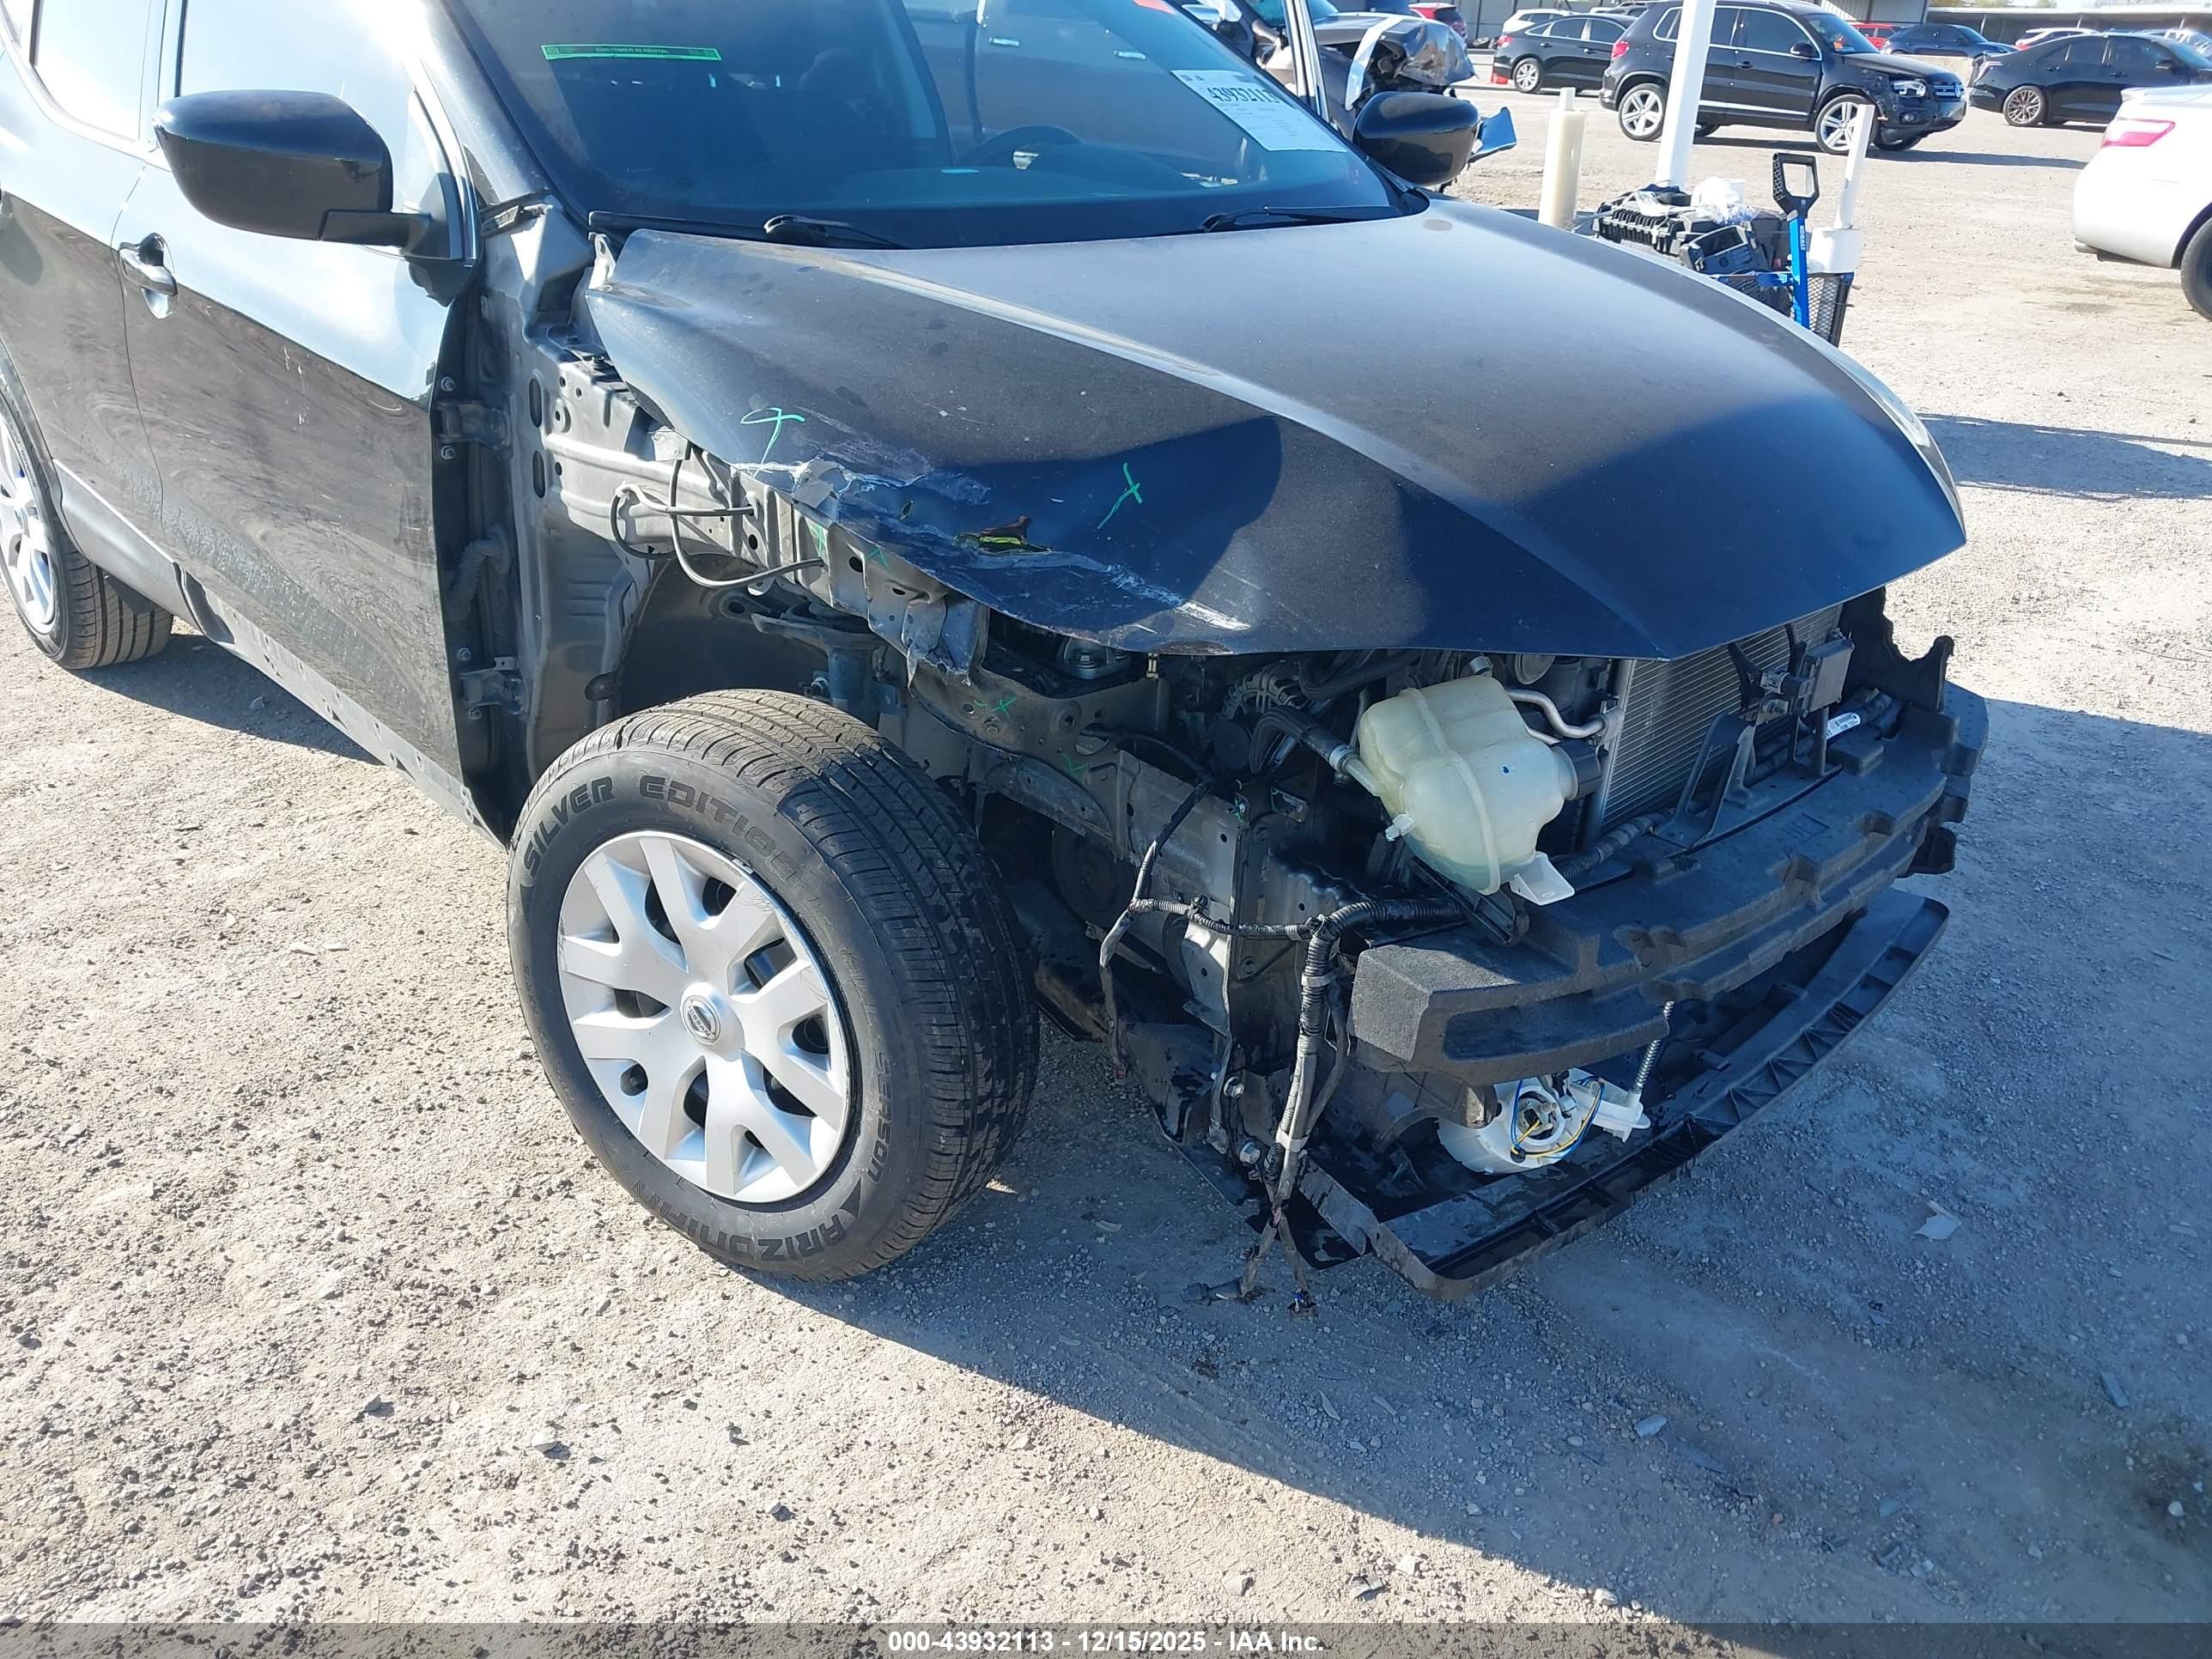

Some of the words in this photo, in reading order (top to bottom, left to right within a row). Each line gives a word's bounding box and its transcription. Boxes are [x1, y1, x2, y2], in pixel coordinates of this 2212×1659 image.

[1206, 87, 1280, 104] 43932113
[522, 775, 617, 878] SILVER
[638, 775, 799, 886] EDITION
[688, 1002, 712, 1036] NISSAN
[866, 1050, 894, 1183] SEASON
[632, 1180, 848, 1261] ARIZONIAN
